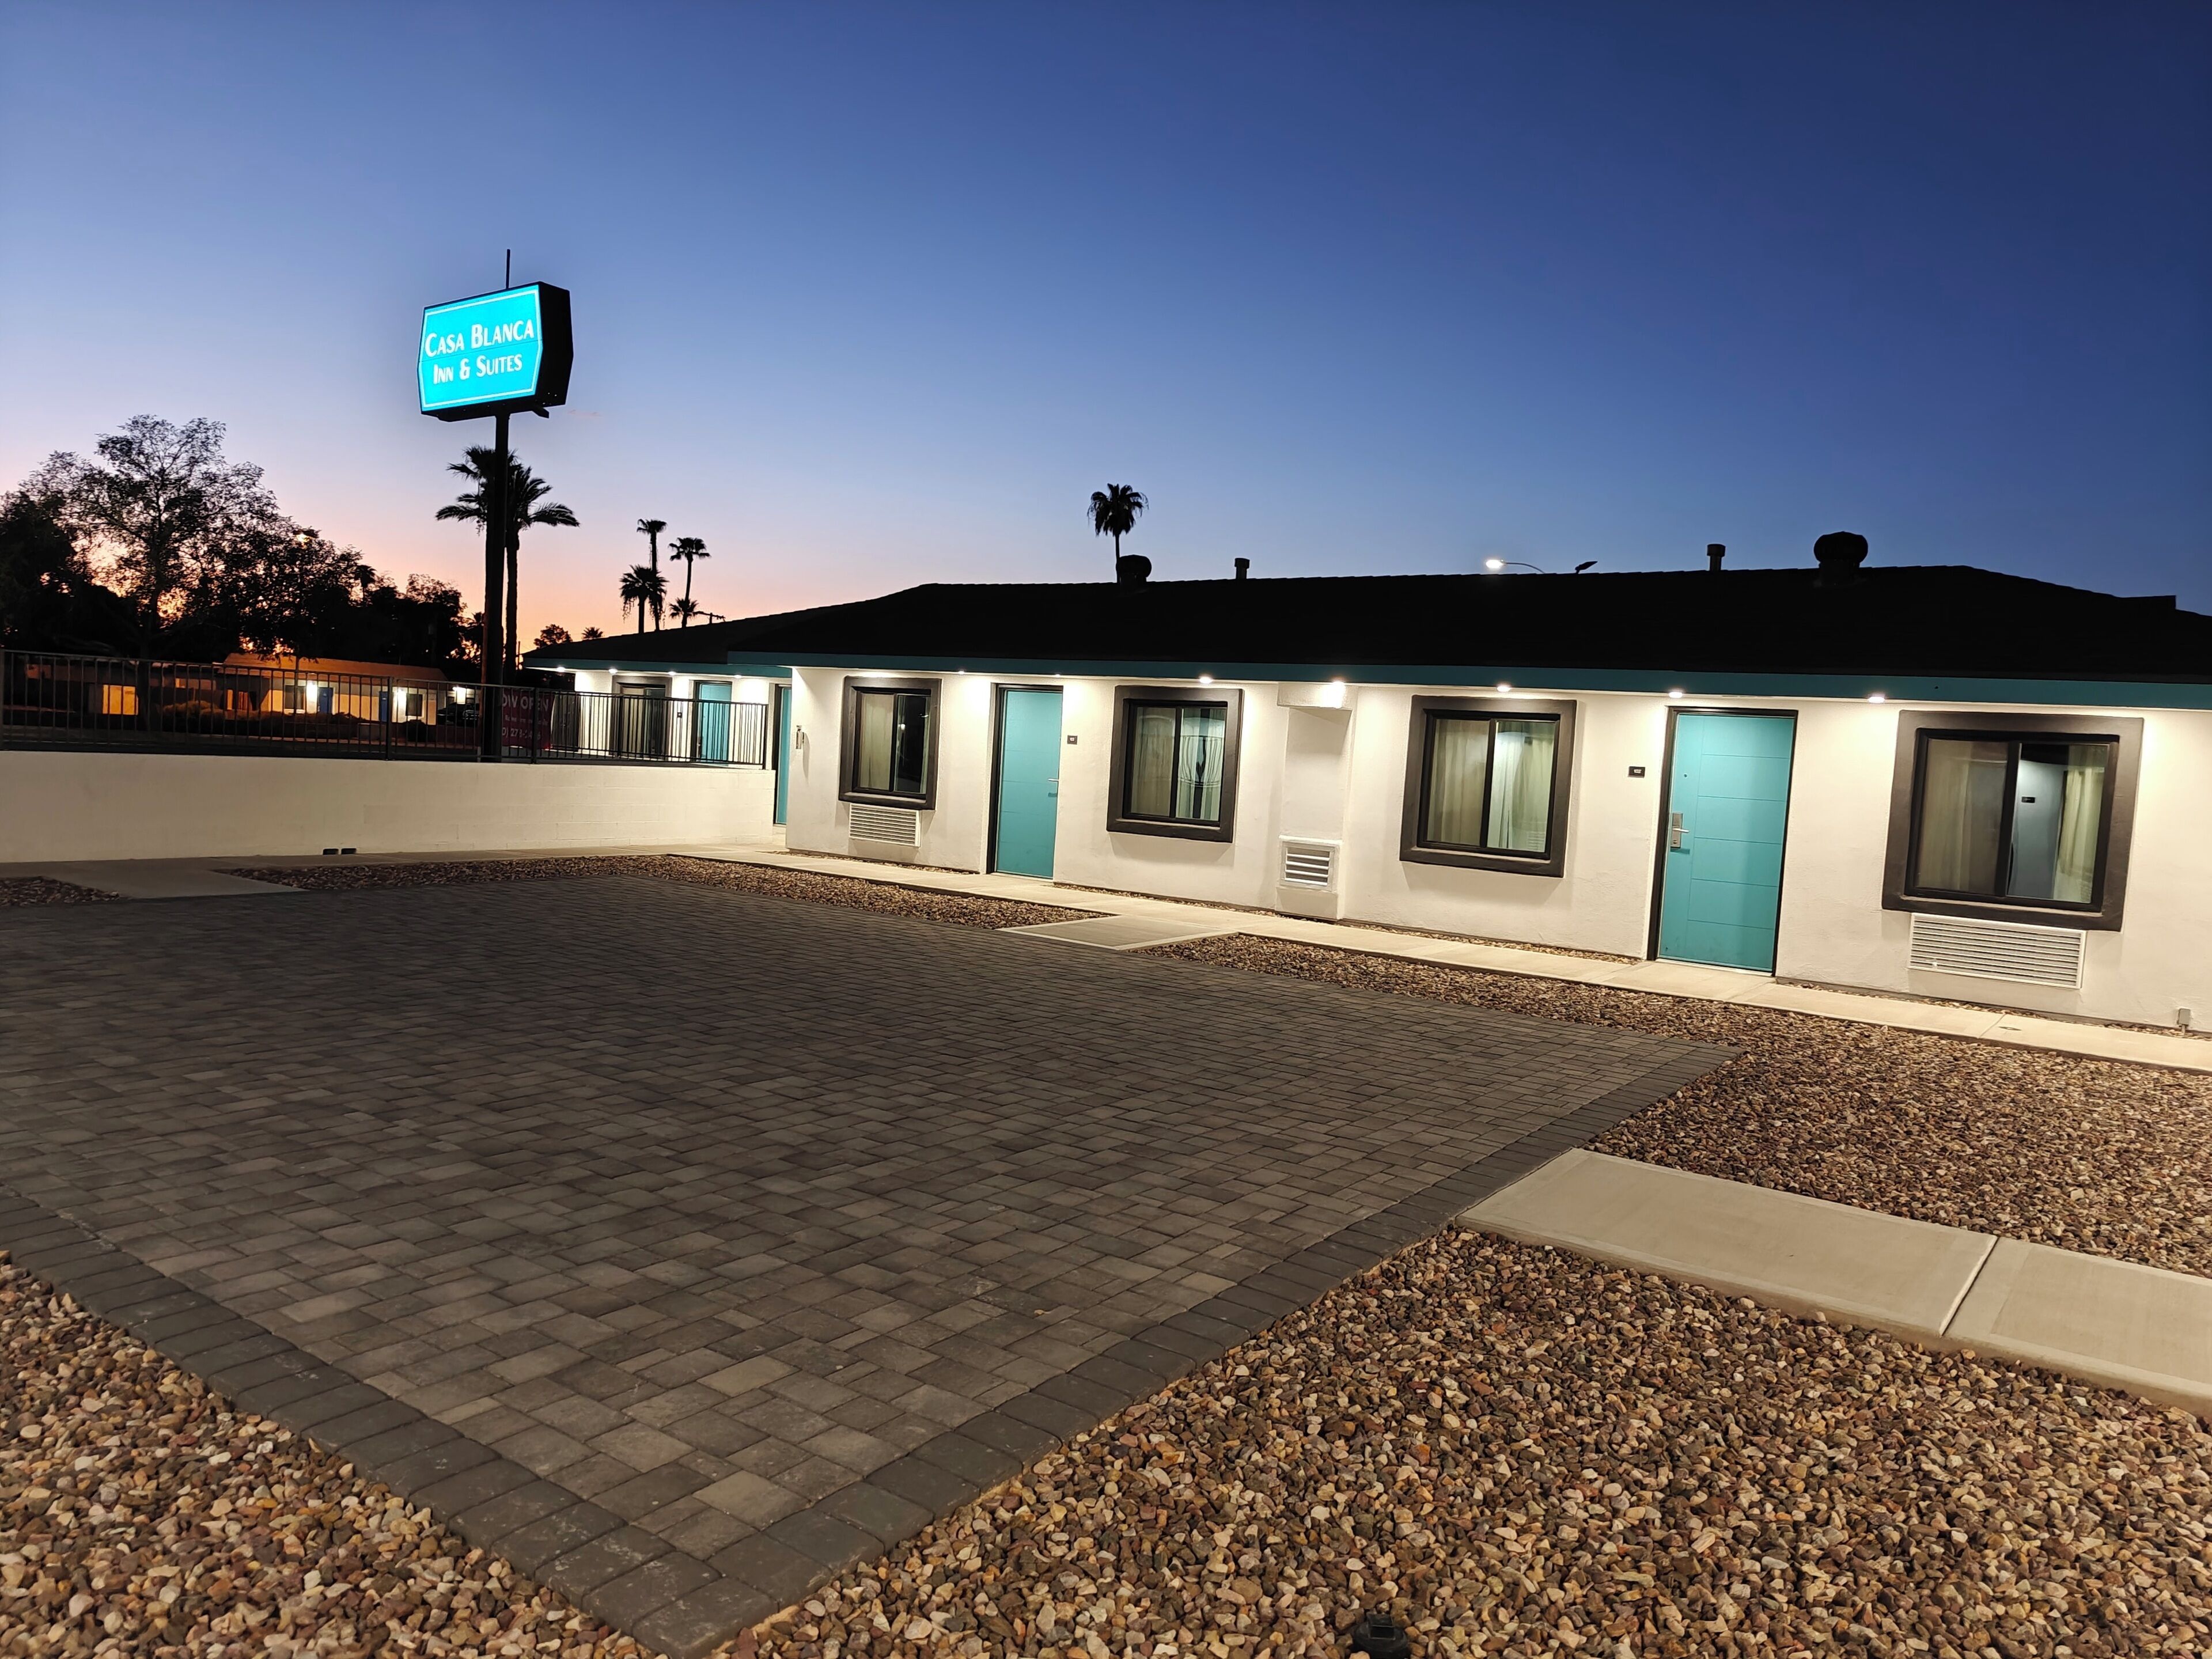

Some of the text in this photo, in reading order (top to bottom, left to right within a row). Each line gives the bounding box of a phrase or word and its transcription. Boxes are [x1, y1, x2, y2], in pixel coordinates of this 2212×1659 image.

[425, 320, 534, 357] CASA BLANCA
[434, 354, 522, 384] INN & SUITES
